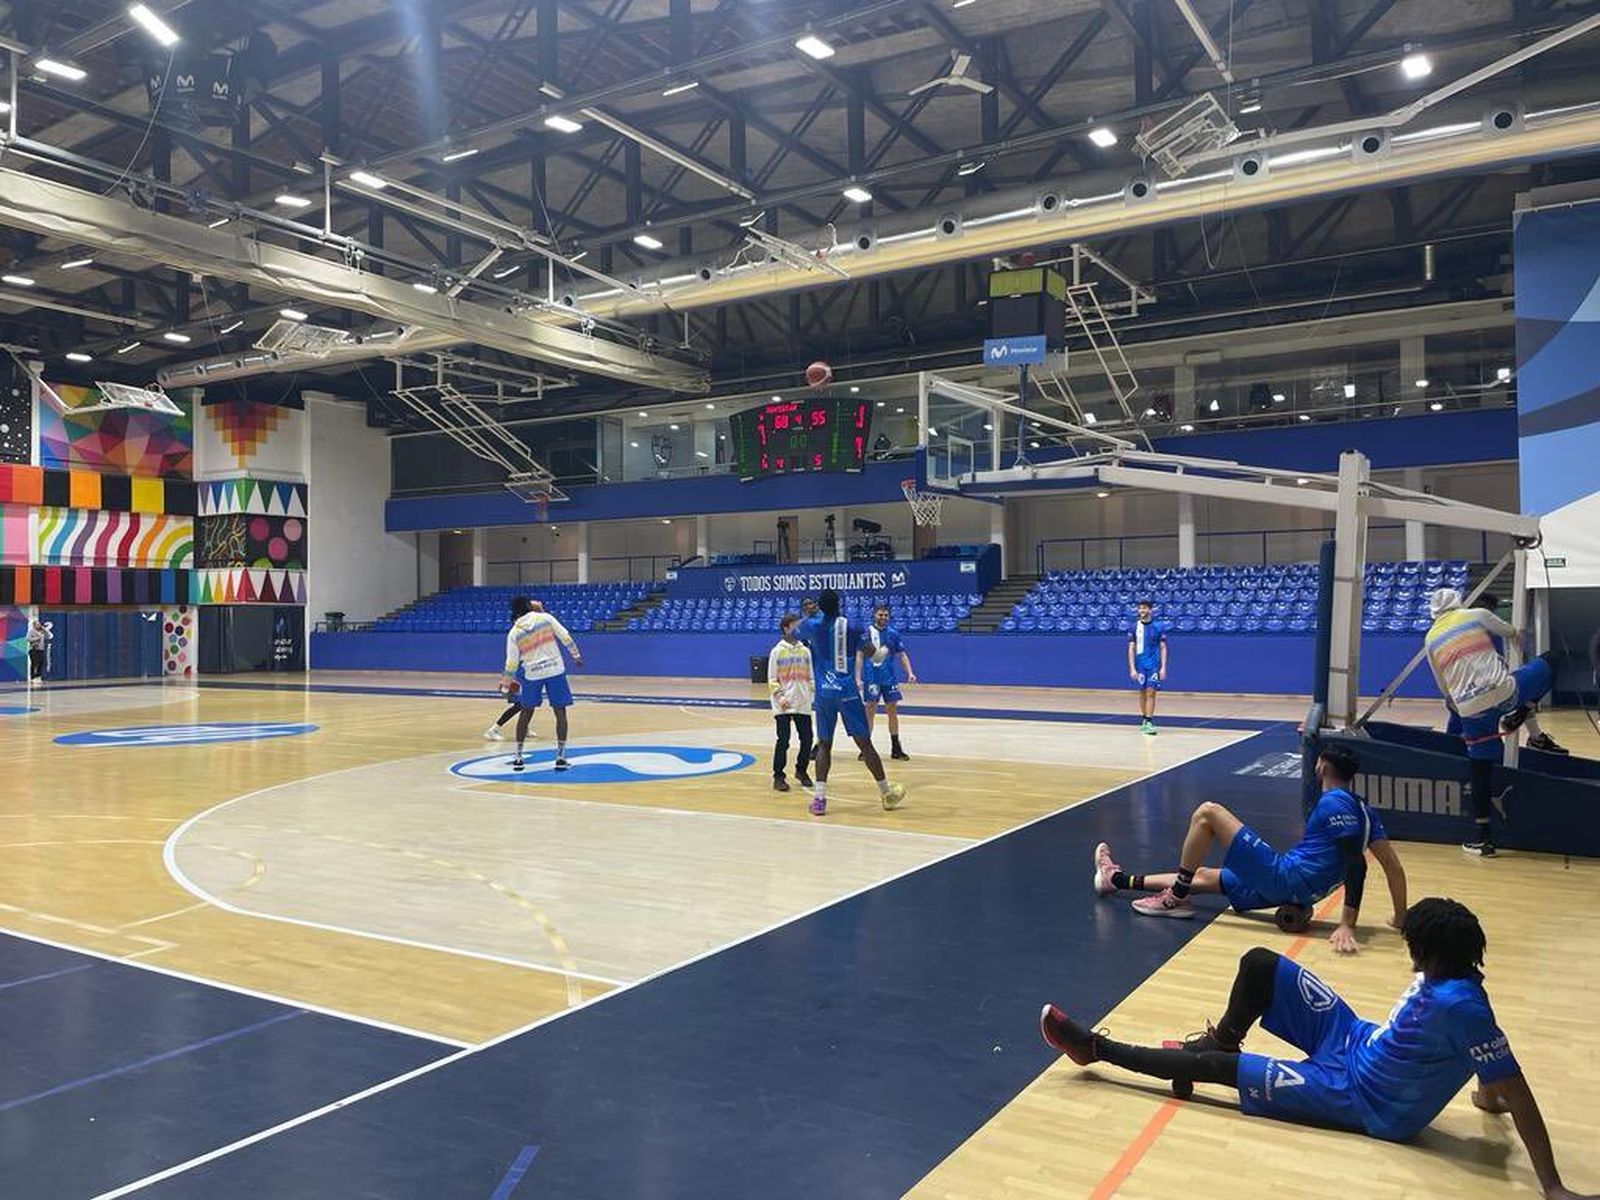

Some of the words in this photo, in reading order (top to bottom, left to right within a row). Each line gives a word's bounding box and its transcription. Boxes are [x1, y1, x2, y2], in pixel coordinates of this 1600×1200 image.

[811, 410, 826, 426] 55
[740, 576, 771, 591] TODOS
[773, 574, 806, 591] SOMOS
[809, 572, 886, 590] ESTUDIANTES
